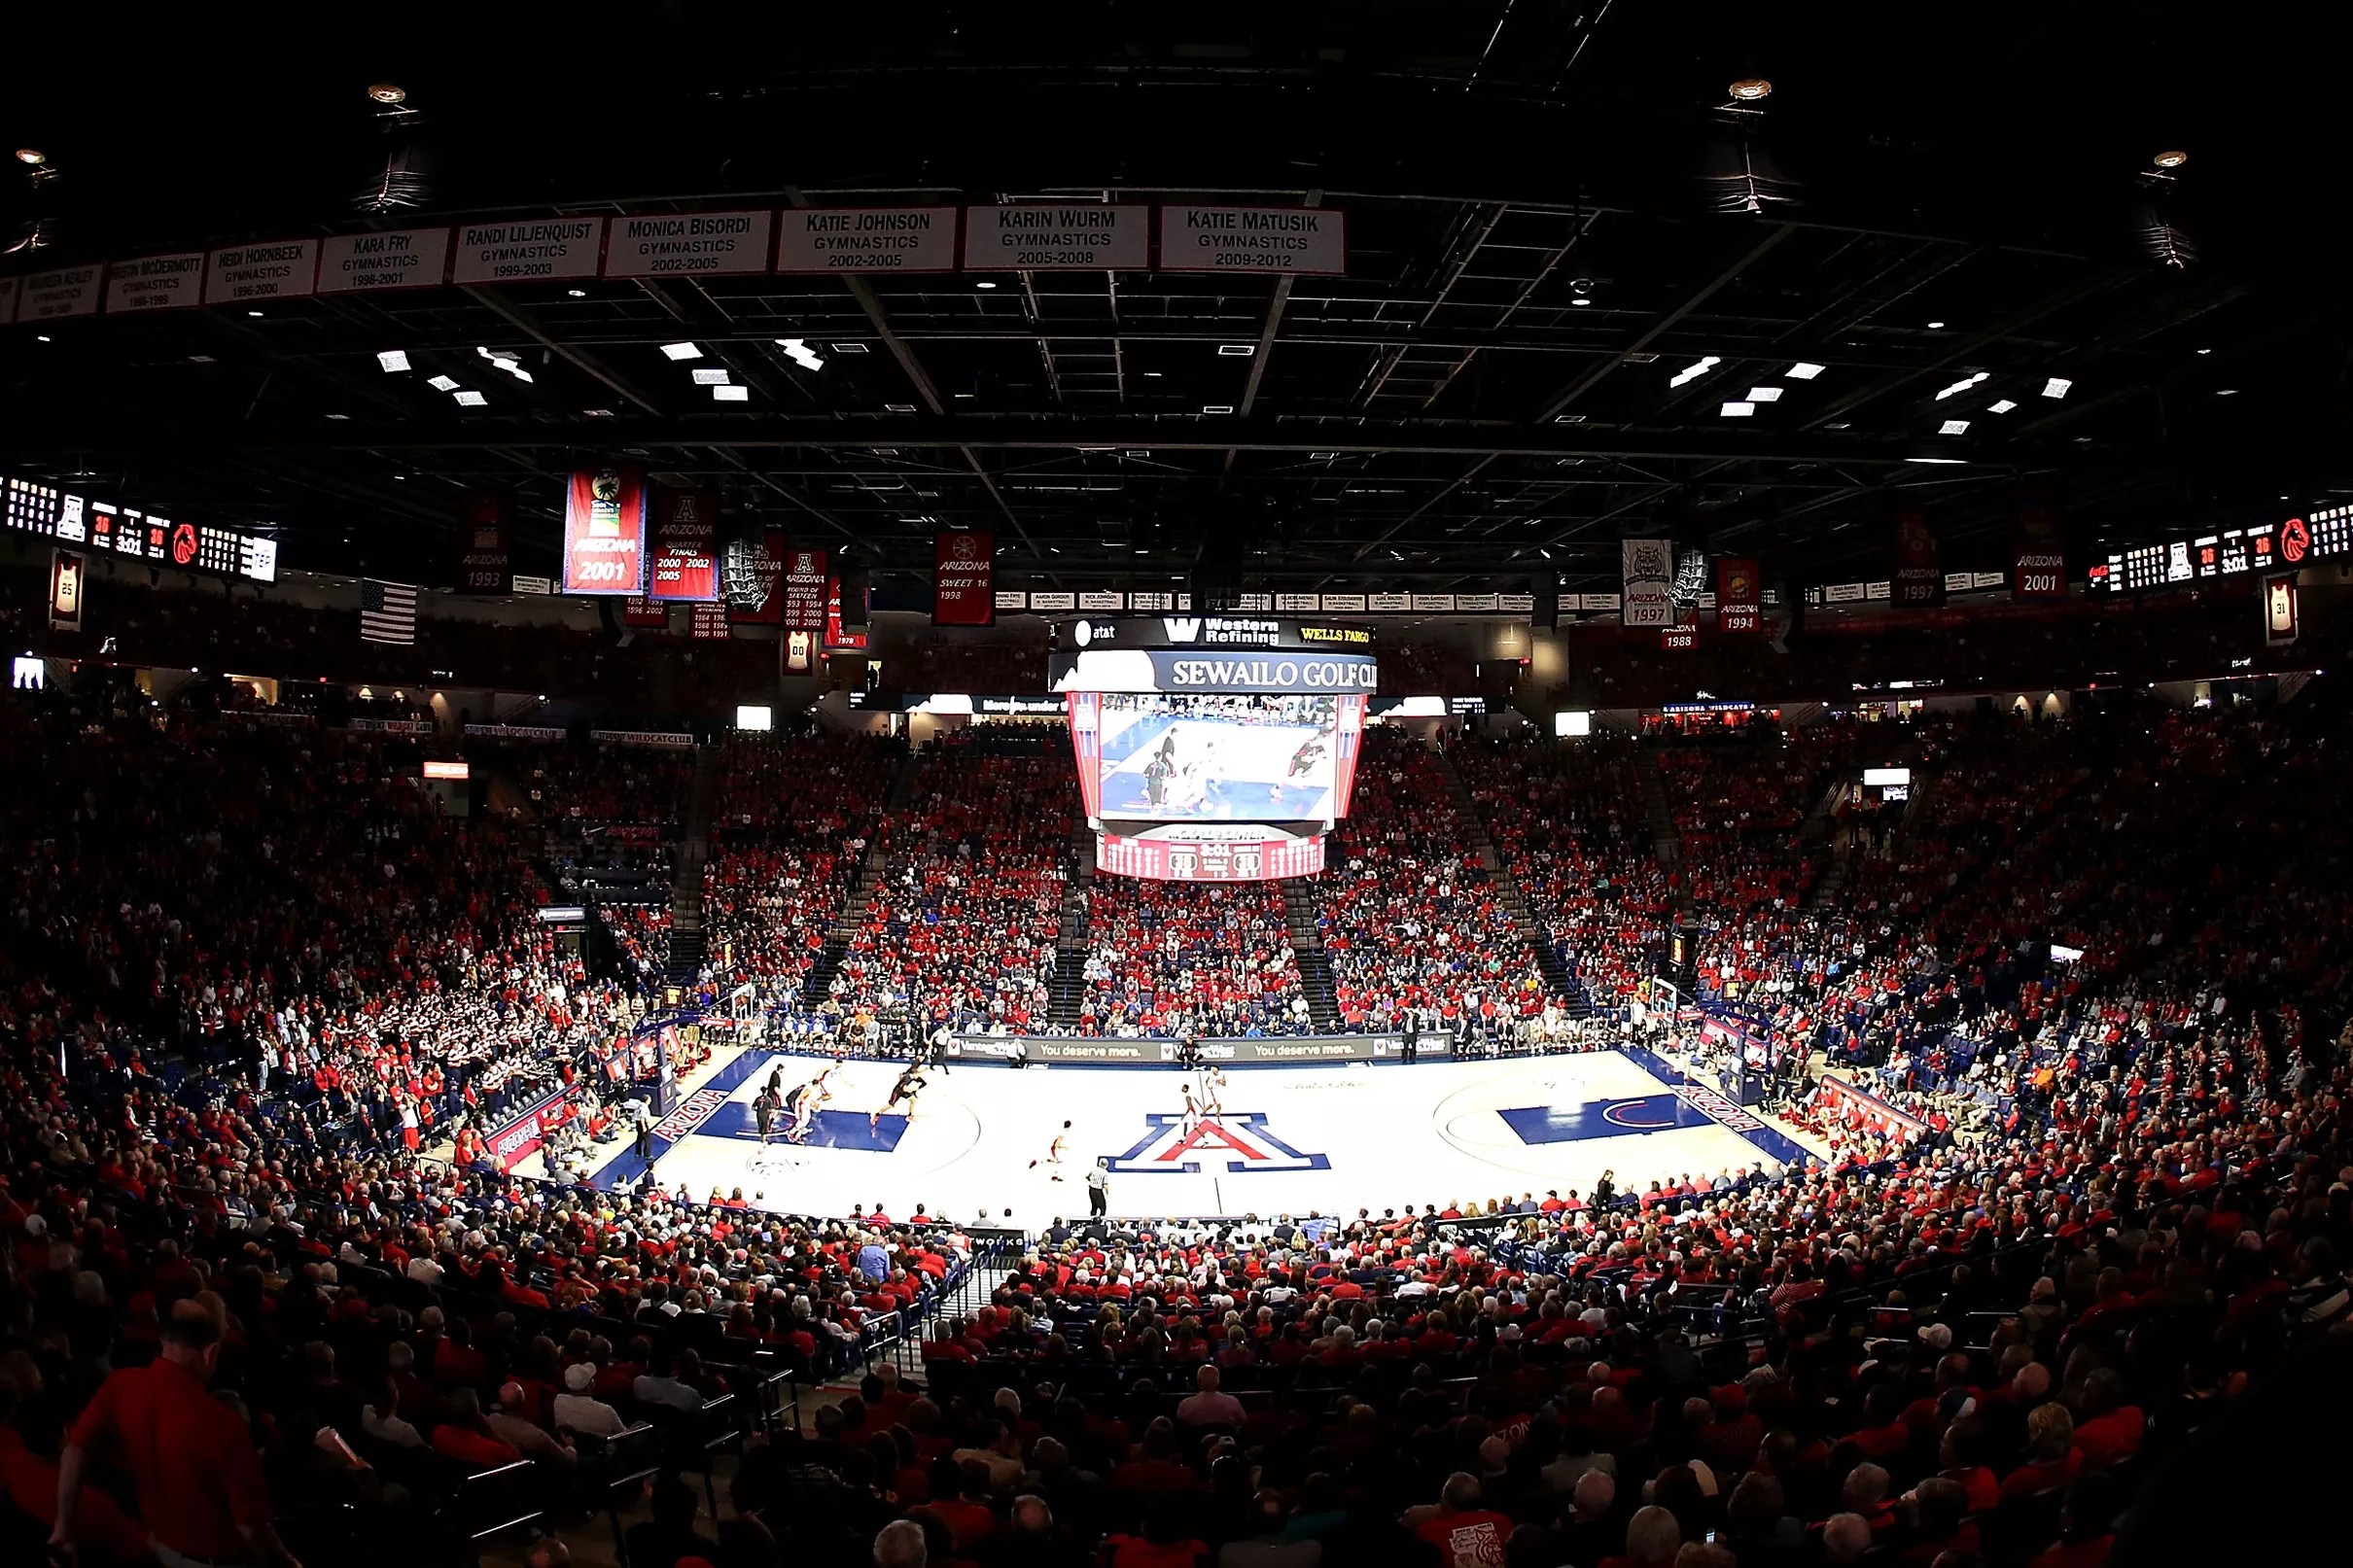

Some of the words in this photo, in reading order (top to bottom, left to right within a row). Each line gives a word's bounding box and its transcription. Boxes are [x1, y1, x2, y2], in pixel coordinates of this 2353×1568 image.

[806, 214, 851, 231] KATIE
[855, 213, 931, 231] JOHNSON
[999, 210, 1052, 227] KARIN
[1059, 211, 1115, 227] WURM
[1187, 211, 1236, 229] KATIE
[1243, 212, 1318, 232] MATUSIK
[628, 219, 685, 238] MONICA
[689, 216, 751, 236] BISORDI
[466, 227, 506, 246] RANDI
[814, 235, 919, 250] GYMNASTICS
[1001, 233, 1111, 246] GYMNASTICS
[1198, 234, 1308, 250] GYMNASTICS
[354, 238, 385, 255] KARA
[389, 235, 412, 252] FRY
[639, 239, 735, 256] GYMNASTICS
[219, 253, 242, 268] HEIDI
[246, 245, 303, 264] HORNBEEK
[481, 245, 567, 261] GYMNASTICS
[1017, 252, 1094, 263] 2005-2008
[1215, 253, 1292, 266] 2009-2012
[342, 255, 419, 271] GYMNASTICS
[650, 258, 719, 271] 2002-2005
[828, 255, 901, 266] 2002-2005
[225, 266, 291, 283] GYMNASTICS
[493, 262, 552, 277] 1999-2003
[123, 278, 180, 293] GYMNASTICS
[352, 272, 404, 286] 1998-2001
[659, 524, 713, 536] ARIZONA
[116, 536, 142, 555] 3:01
[573, 538, 636, 553] ARIZONA
[2256, 538, 2269, 553] 36
[462, 554, 508, 566] ARIZONA
[2018, 555, 2063, 567] ARIZONA
[2201, 548, 2214, 564] 36
[656, 558, 682, 569] 2000
[685, 558, 710, 569] 2002
[939, 561, 990, 572] ARIZONA
[2222, 555, 2248, 574] 3:01
[579, 561, 625, 581] 2001
[656, 571, 682, 580] 2005
[1897, 568, 1940, 578] ARIZONA
[468, 572, 501, 586] 1993
[786, 575, 825, 584] ARIZONA
[939, 578, 973, 588] SWEET
[977, 578, 988, 587] 16
[2023, 575, 2056, 591] 2001
[61, 582, 72, 595] 25
[939, 590, 961, 600] 1998
[1904, 585, 1934, 600] 1997
[1633, 609, 1665, 621] 1997
[1721, 605, 1759, 613] ARIZONA
[2276, 603, 2285, 614] 31
[803, 618, 822, 627] 2002
[1205, 618, 1280, 631] Western
[1727, 617, 1753, 629] 1994
[1206, 630, 1280, 645] Refining
[1300, 627, 1343, 643] WELLS
[1344, 629, 1370, 644] FARGO
[1667, 637, 1692, 646] 1988
[792, 646, 804, 656] 00
[1173, 660, 1298, 686] SEWAILO
[1302, 662, 1357, 687] GOLF
[626, 734, 668, 743] WILDCAT
[668, 735, 692, 744] CLUB
[1040, 1044, 1061, 1057] You
[1063, 1044, 1106, 1058] deserve
[1108, 1046, 1142, 1058] more.
[1254, 1045, 1274, 1057] You
[1276, 1044, 1317, 1057] deserve
[1318, 1044, 1354, 1056] more.
[1670, 1084, 1766, 1132] ARIZONA
[650, 1088, 730, 1143] ARIZONA
